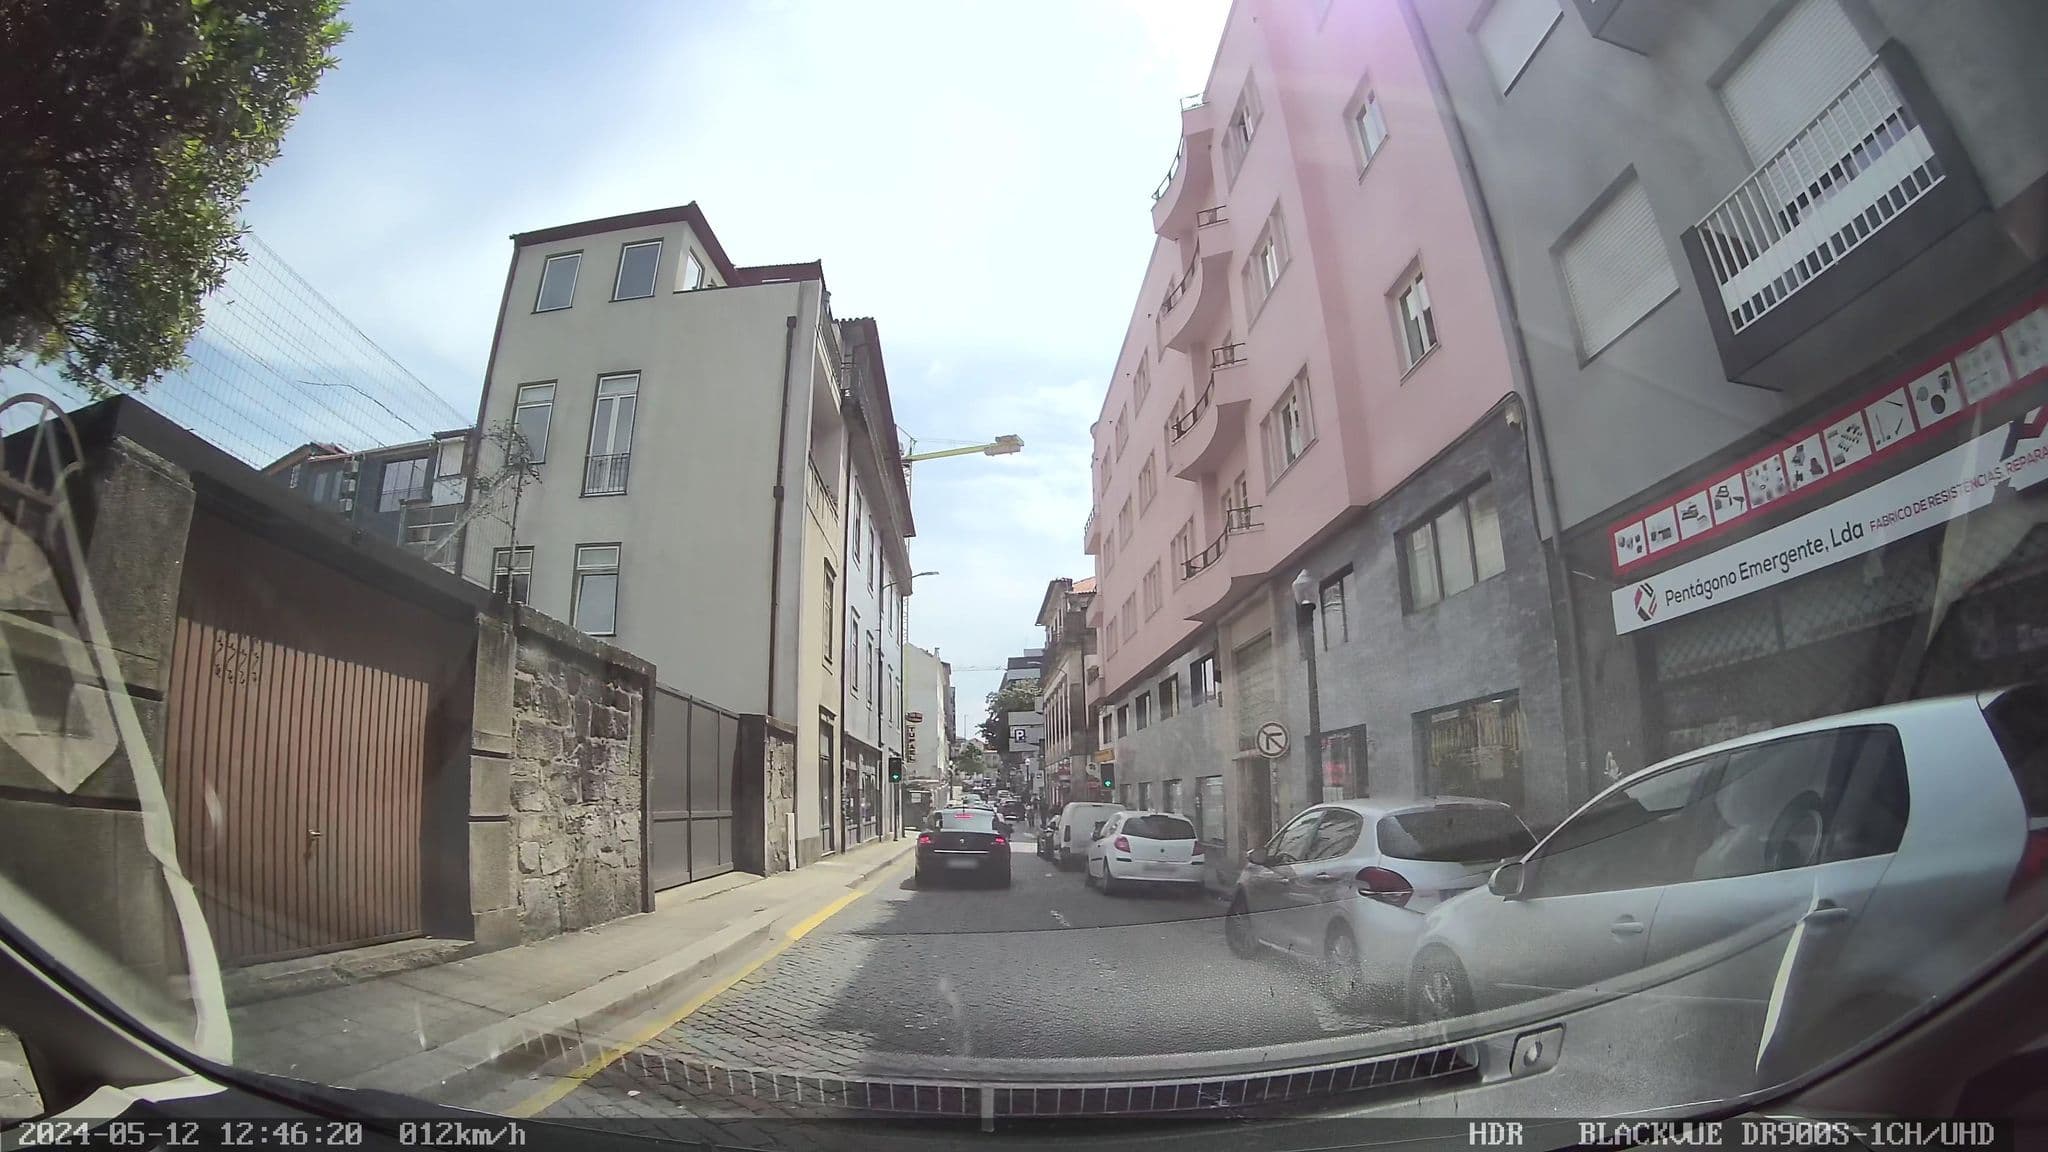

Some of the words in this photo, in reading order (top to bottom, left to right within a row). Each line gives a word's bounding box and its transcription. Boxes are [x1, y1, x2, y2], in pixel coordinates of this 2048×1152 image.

[1869, 505, 1912, 532] FABRICO
[1913, 499, 1927, 514] DE
[1665, 569, 1737, 606] Pentágono
[1738, 537, 1829, 581] Emergente,
[1830, 521, 1864, 548] Lda
